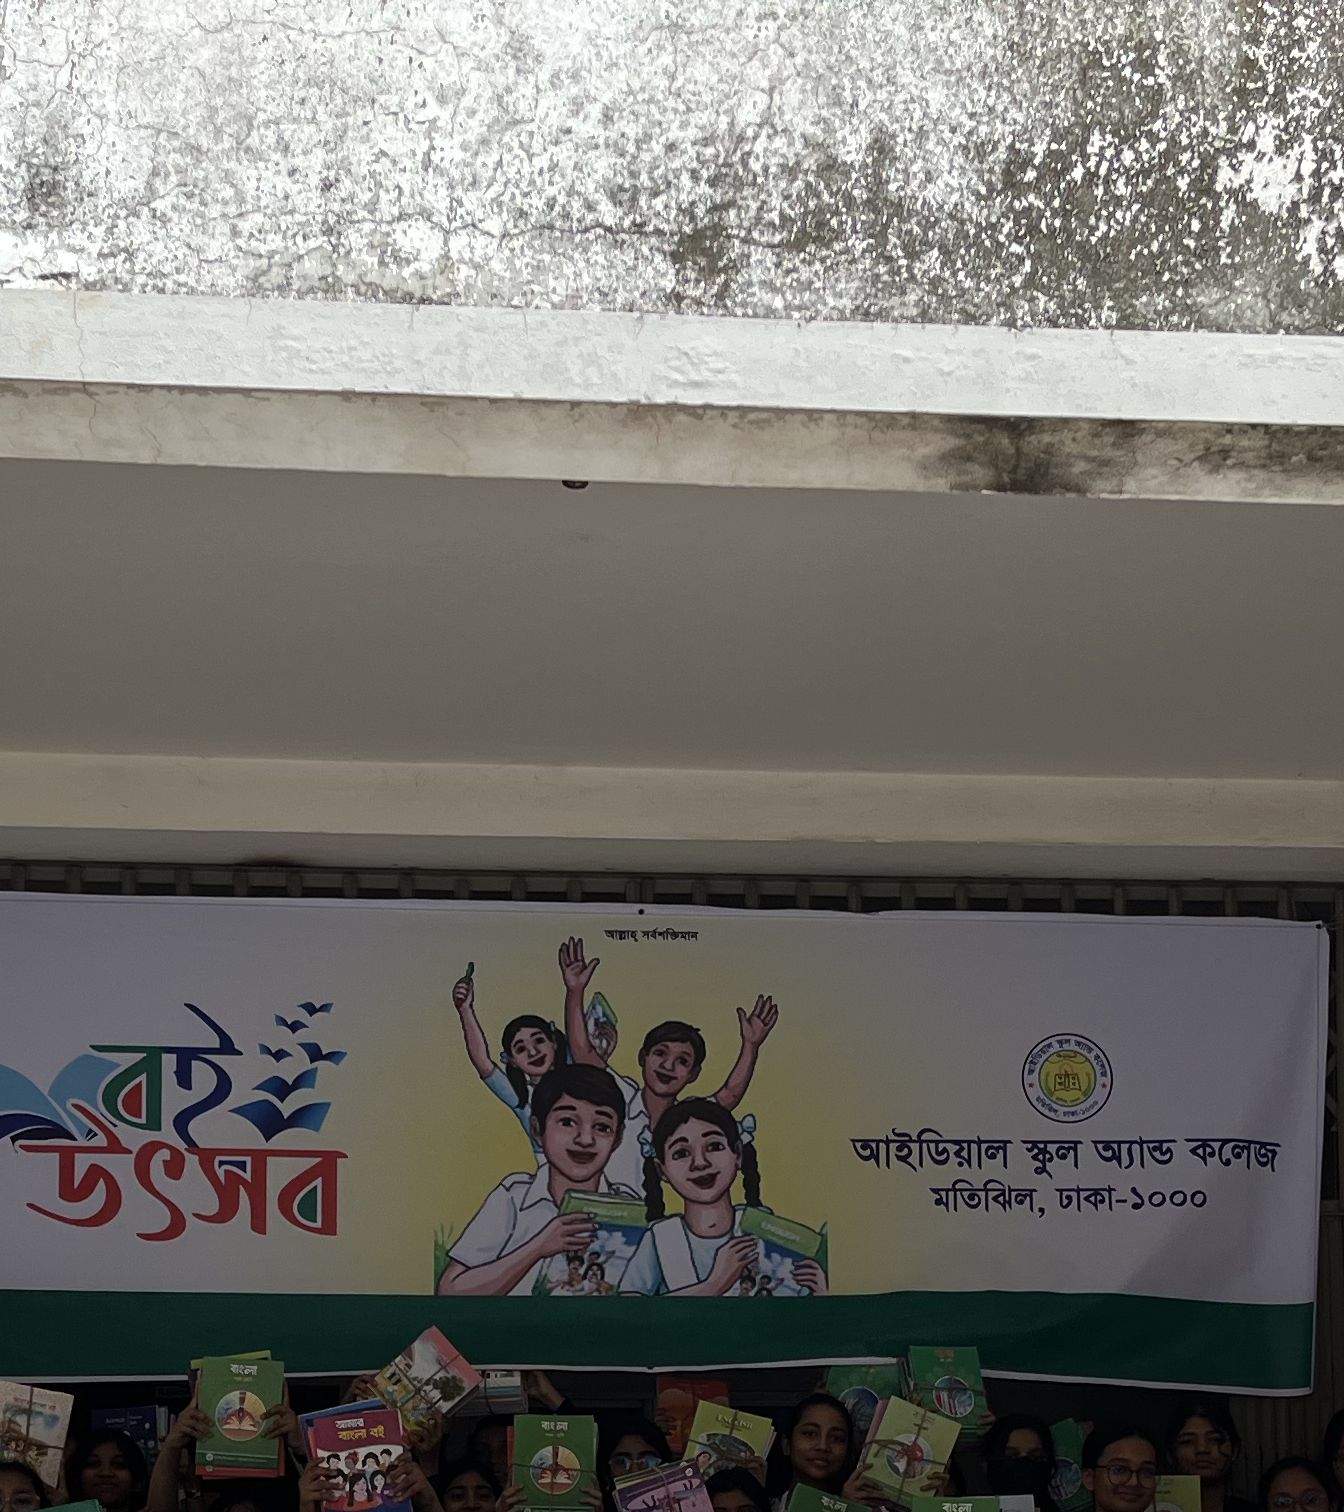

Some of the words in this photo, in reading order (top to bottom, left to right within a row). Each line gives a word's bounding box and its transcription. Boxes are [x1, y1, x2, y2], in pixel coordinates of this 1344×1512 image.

[89, 1002, 243, 1147] বই
[17, 1102, 348, 1241] উৎসব
[851, 1127, 1012, 1172] আইডিয়াল
[1021, 1137, 1082, 1179] স্কুল
[1092, 1136, 1176, 1171] অ্যান্ড
[1184, 1138, 1280, 1172] কলেজ
[930, 1179, 1045, 1218] মতিঝিল,
[1055, 1184, 1206, 1213] ঢাকা-১০০০
[230, 1363, 258, 1375] বাংলা
